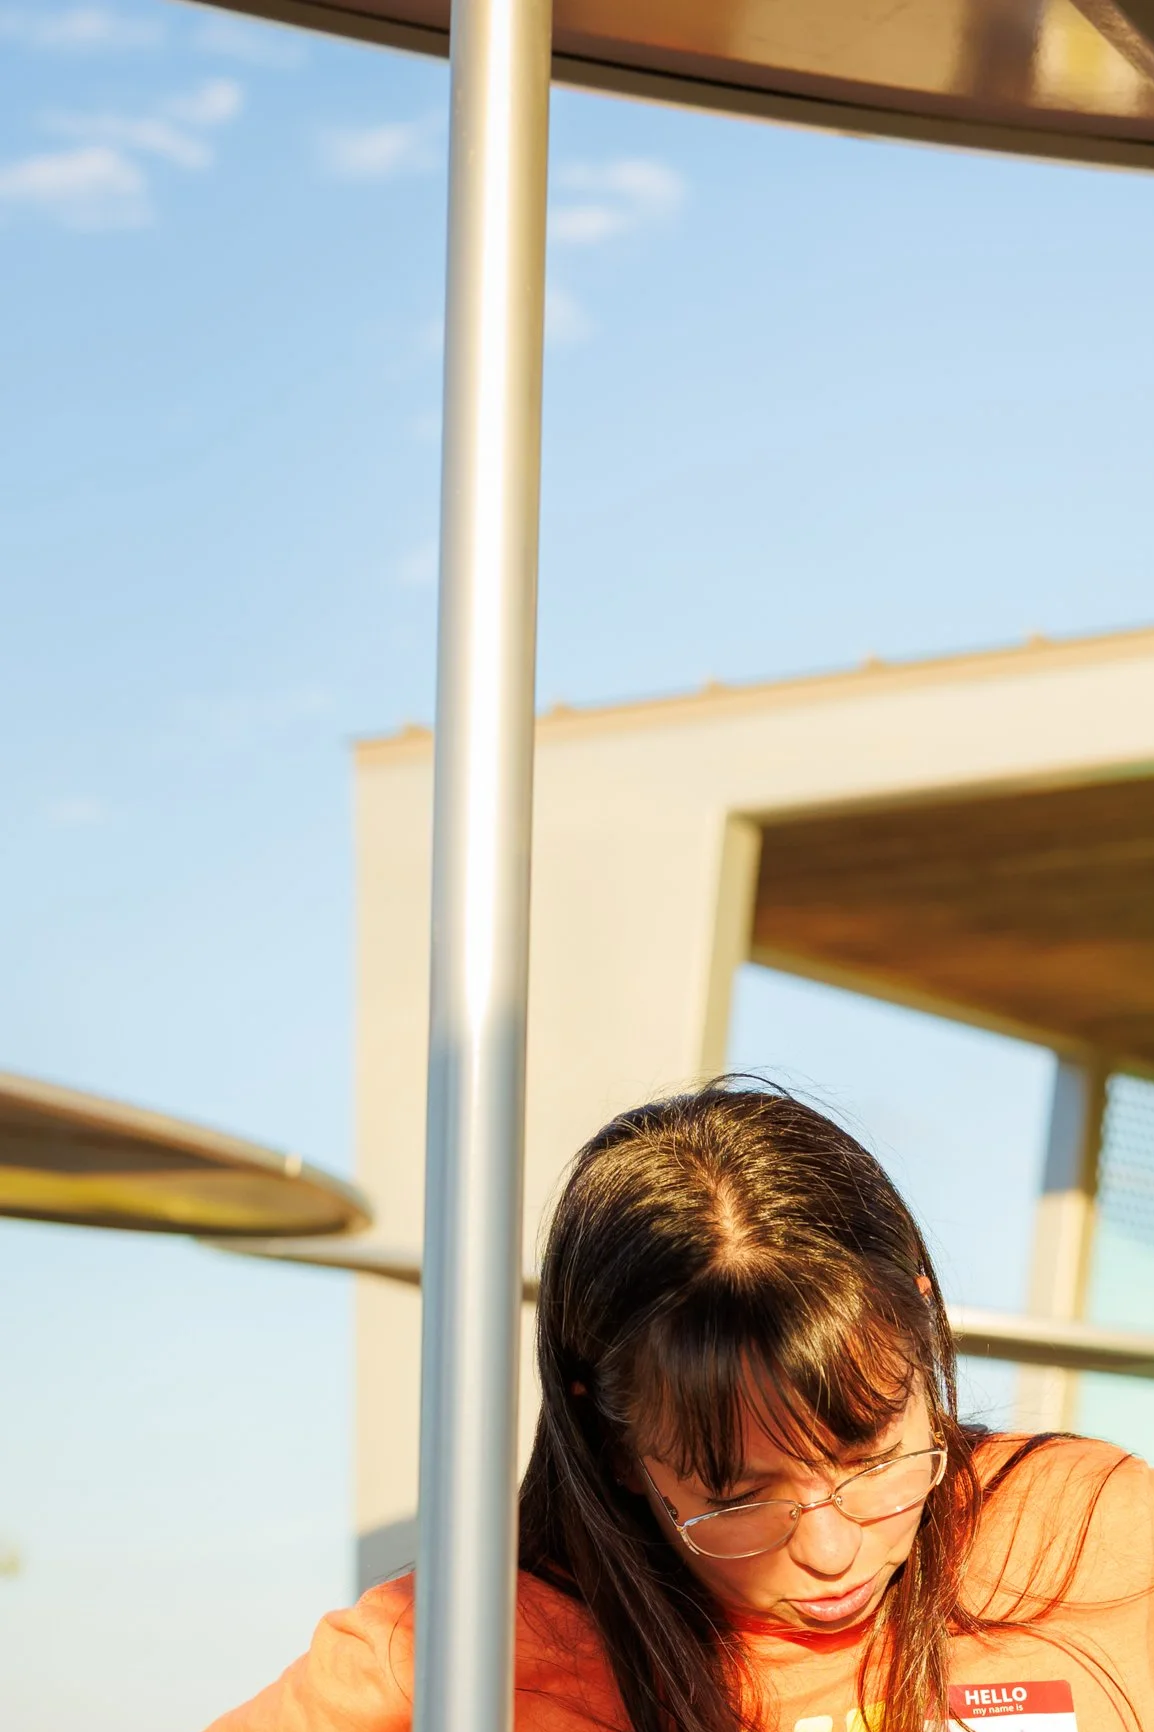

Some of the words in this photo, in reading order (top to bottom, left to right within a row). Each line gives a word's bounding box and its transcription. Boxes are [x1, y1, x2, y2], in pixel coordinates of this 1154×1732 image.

[964, 1686, 1028, 1706] HELLO
[973, 1706, 986, 1716] my
[989, 1705, 1014, 1714] name
[1016, 1703, 1024, 1712] is
